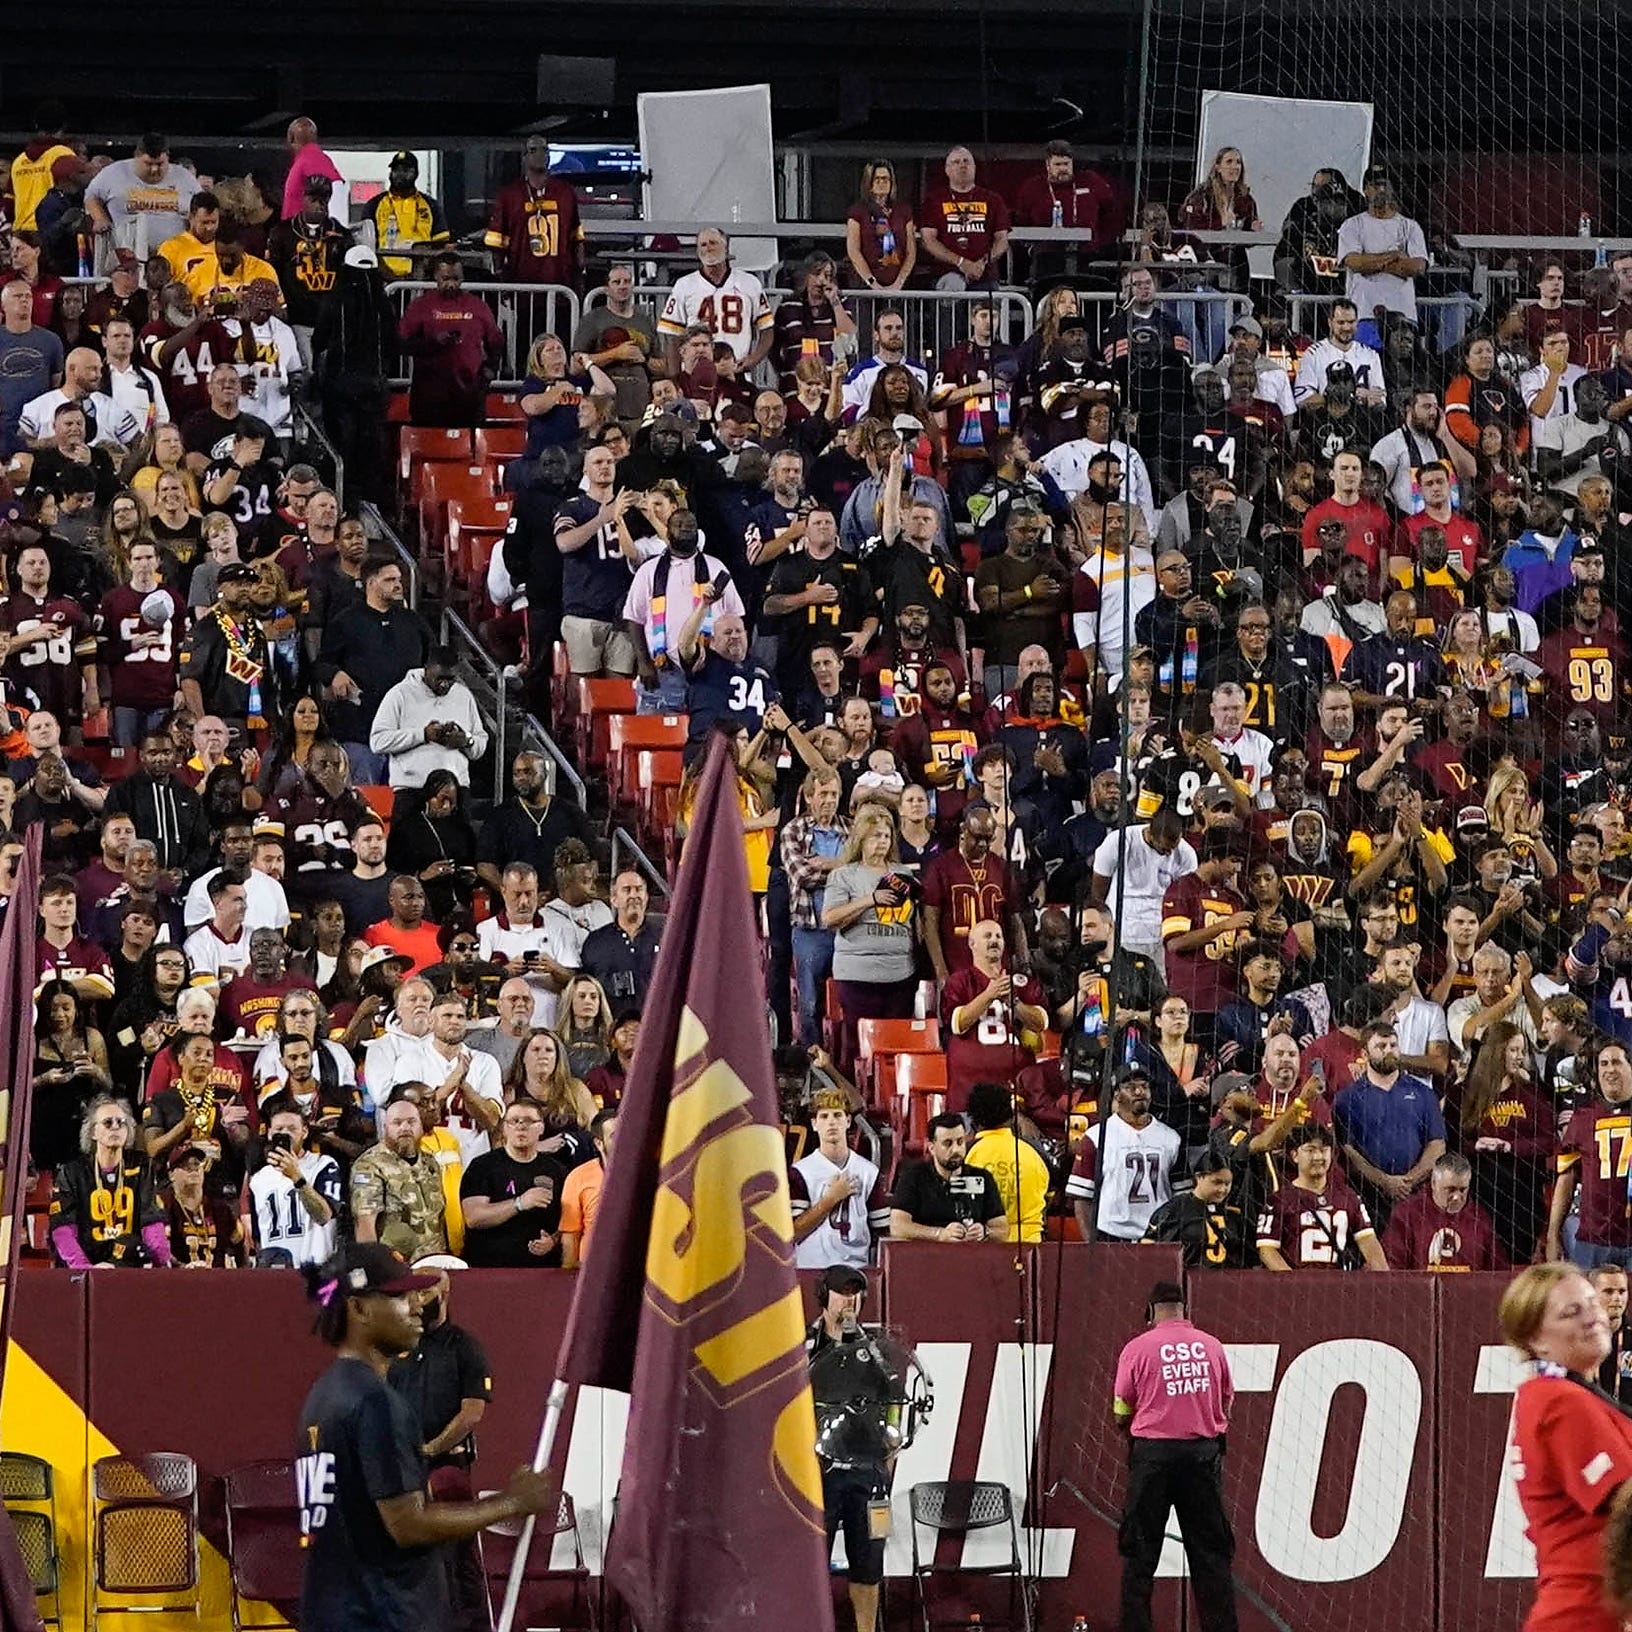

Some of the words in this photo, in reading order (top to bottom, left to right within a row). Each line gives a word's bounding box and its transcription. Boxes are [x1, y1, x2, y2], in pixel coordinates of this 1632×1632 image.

[699, 296, 744, 333] 48
[173, 340, 215, 385] 44
[236, 485, 270, 522] 34
[730, 675, 765, 716] 34
[1386, 661, 1415, 698] 21
[1568, 658, 1613, 701] 93
[1595, 1128, 1632, 1178] 17
[91, 1188, 134, 1239] 99
[266, 1190, 303, 1240] 11
[1159, 1341, 1206, 1363] CSC
[1162, 1361, 1210, 1380] EVENT
[1166, 1378, 1210, 1396] STAFF
